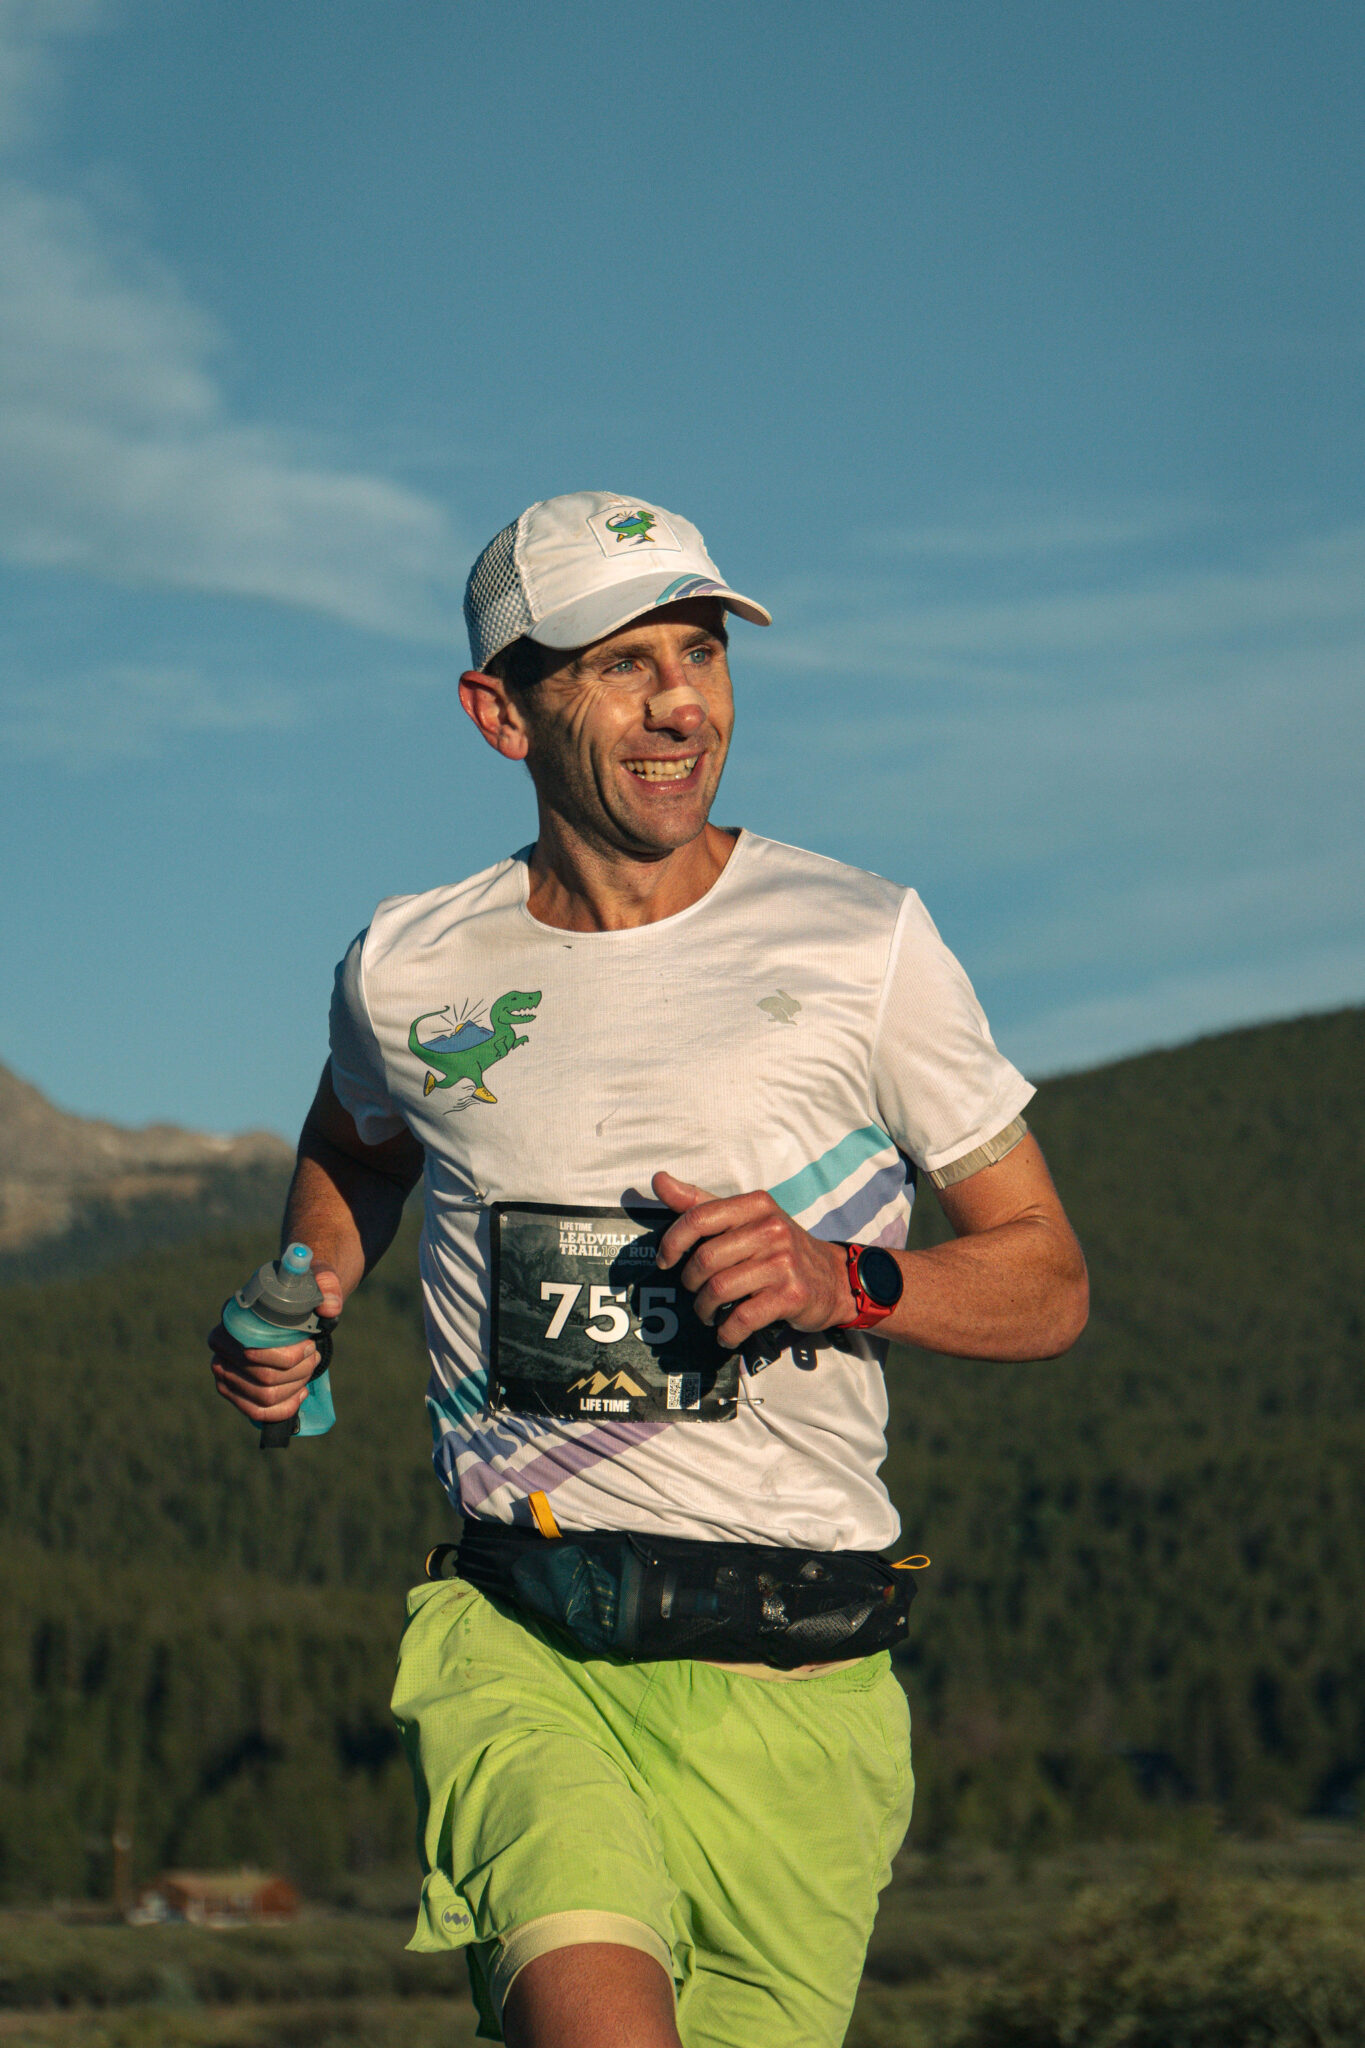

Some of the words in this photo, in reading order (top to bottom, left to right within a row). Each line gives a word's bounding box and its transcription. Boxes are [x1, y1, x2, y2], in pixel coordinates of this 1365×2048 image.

[559, 1232, 639, 1246] LEADVILLE
[559, 1243, 602, 1257] TRAIL
[540, 1281, 679, 1344] 755
[580, 1397, 602, 1411] LIFE
[603, 1399, 630, 1413] TIME
